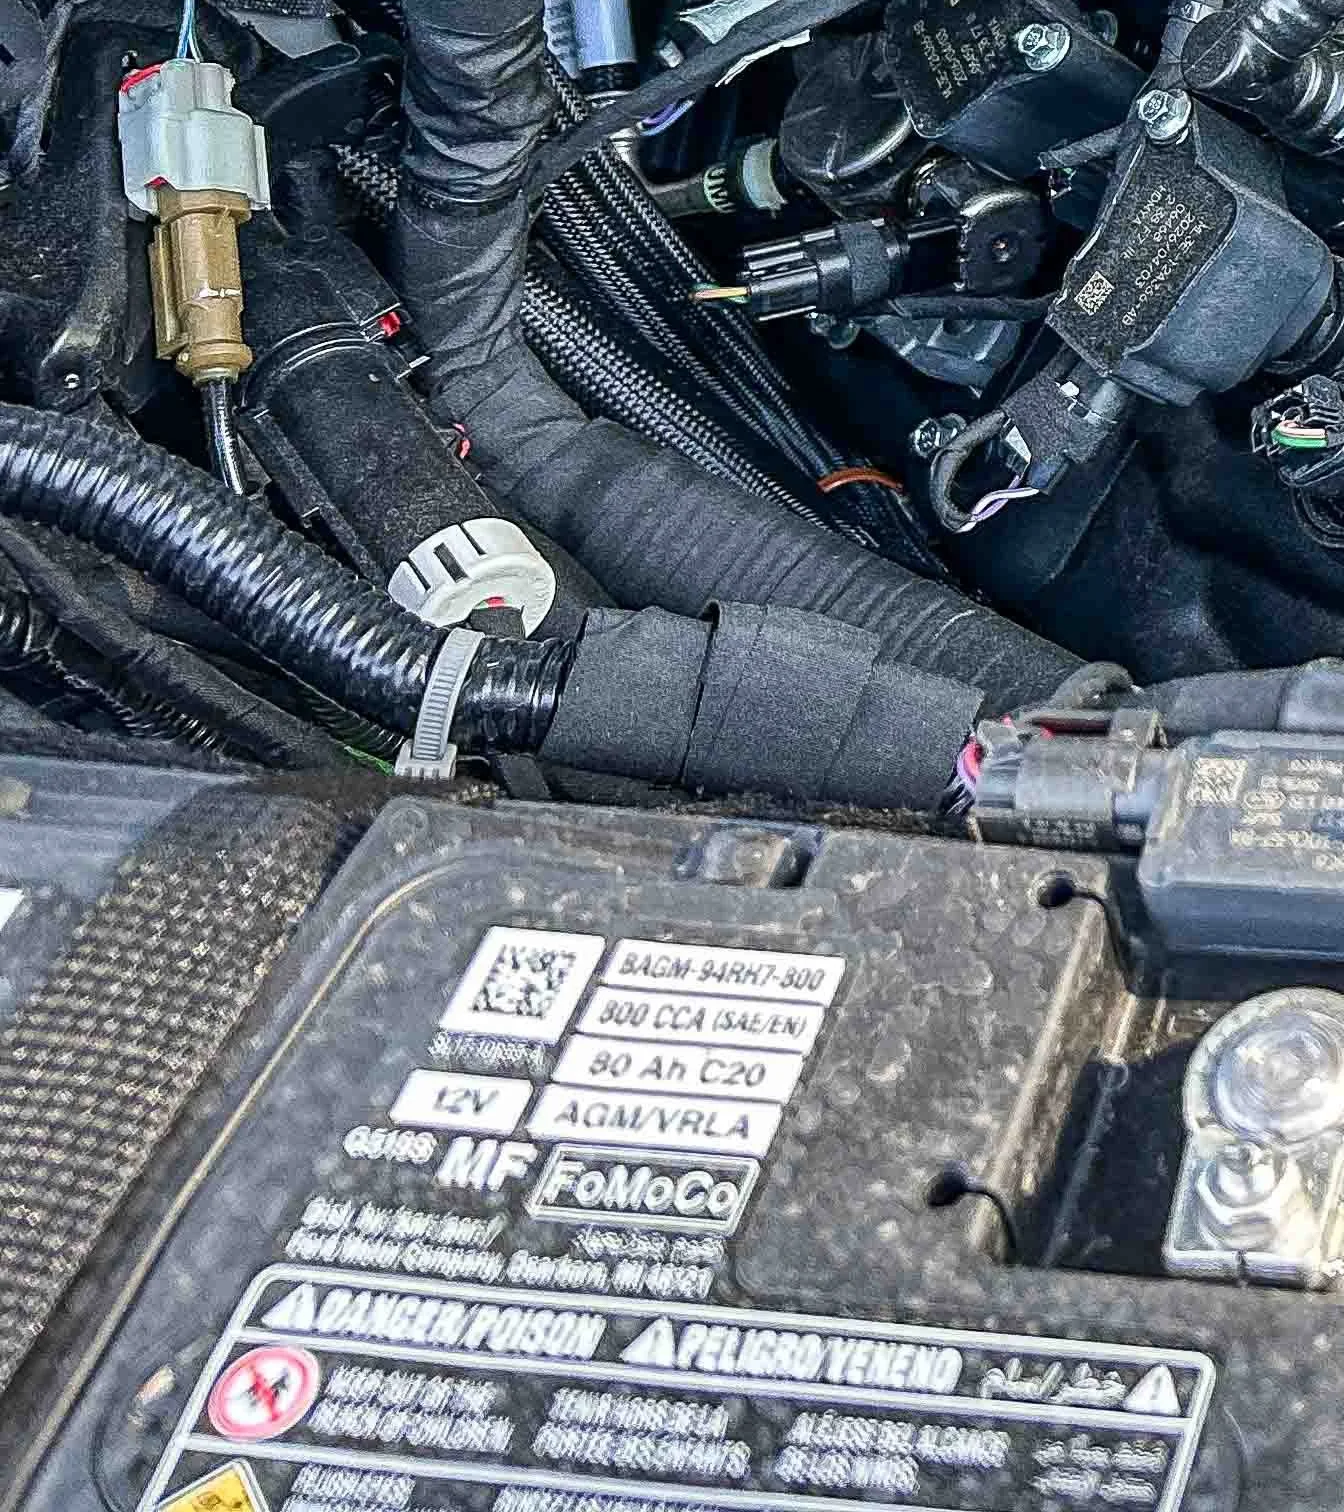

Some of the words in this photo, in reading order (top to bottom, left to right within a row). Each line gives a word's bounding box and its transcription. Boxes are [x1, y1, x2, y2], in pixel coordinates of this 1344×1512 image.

[598, 1000, 650, 1026] 800
[653, 1004, 706, 1032] CCA
[711, 1008, 809, 1038] (SAE/EN)
[587, 1050, 632, 1076] 80
[640, 1055, 687, 1082] Ah
[699, 1058, 767, 1087] C20
[433, 1086, 501, 1116] 12V
[554, 1099, 751, 1139] AGM/VRLA
[435, 1136, 539, 1192] MF
[543, 1157, 739, 1217] FoMoCo
[320, 1286, 608, 1360] DANGER/POISON
[677, 1322, 963, 1394] PELIGRO/VENENO
